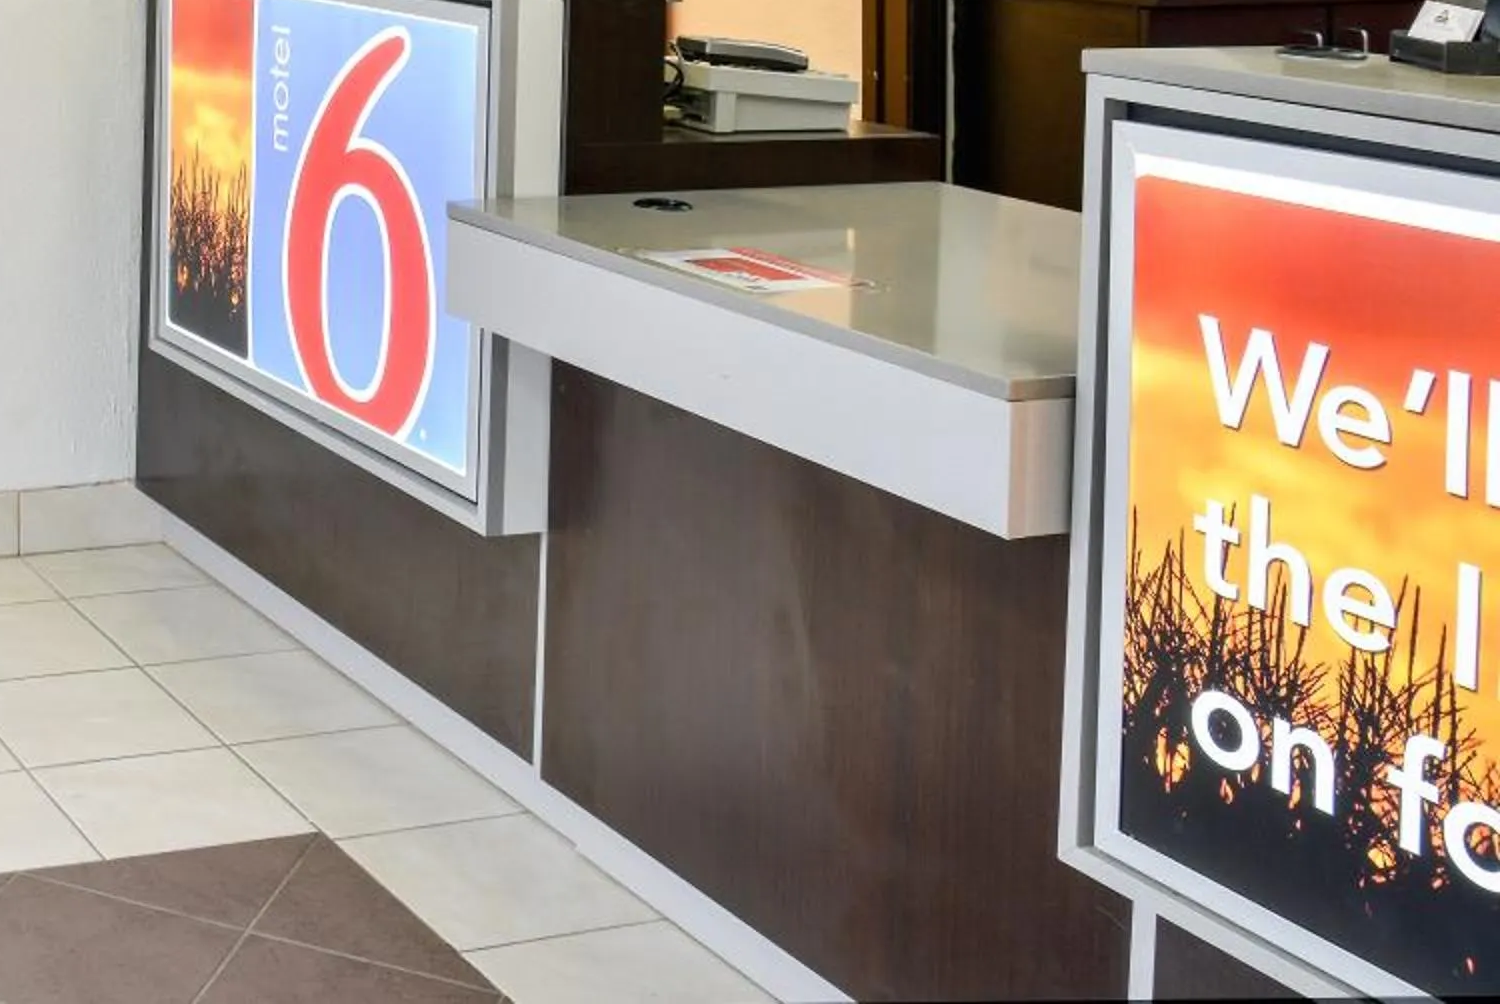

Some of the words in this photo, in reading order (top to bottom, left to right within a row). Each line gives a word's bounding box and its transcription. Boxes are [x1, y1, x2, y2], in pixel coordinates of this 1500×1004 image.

[270, 24, 291, 152] motel
[282, 25, 437, 444] 6
[1193, 495, 1399, 652] the
[1190, 689, 1338, 816] on
[1388, 738, 1500, 894] fo
